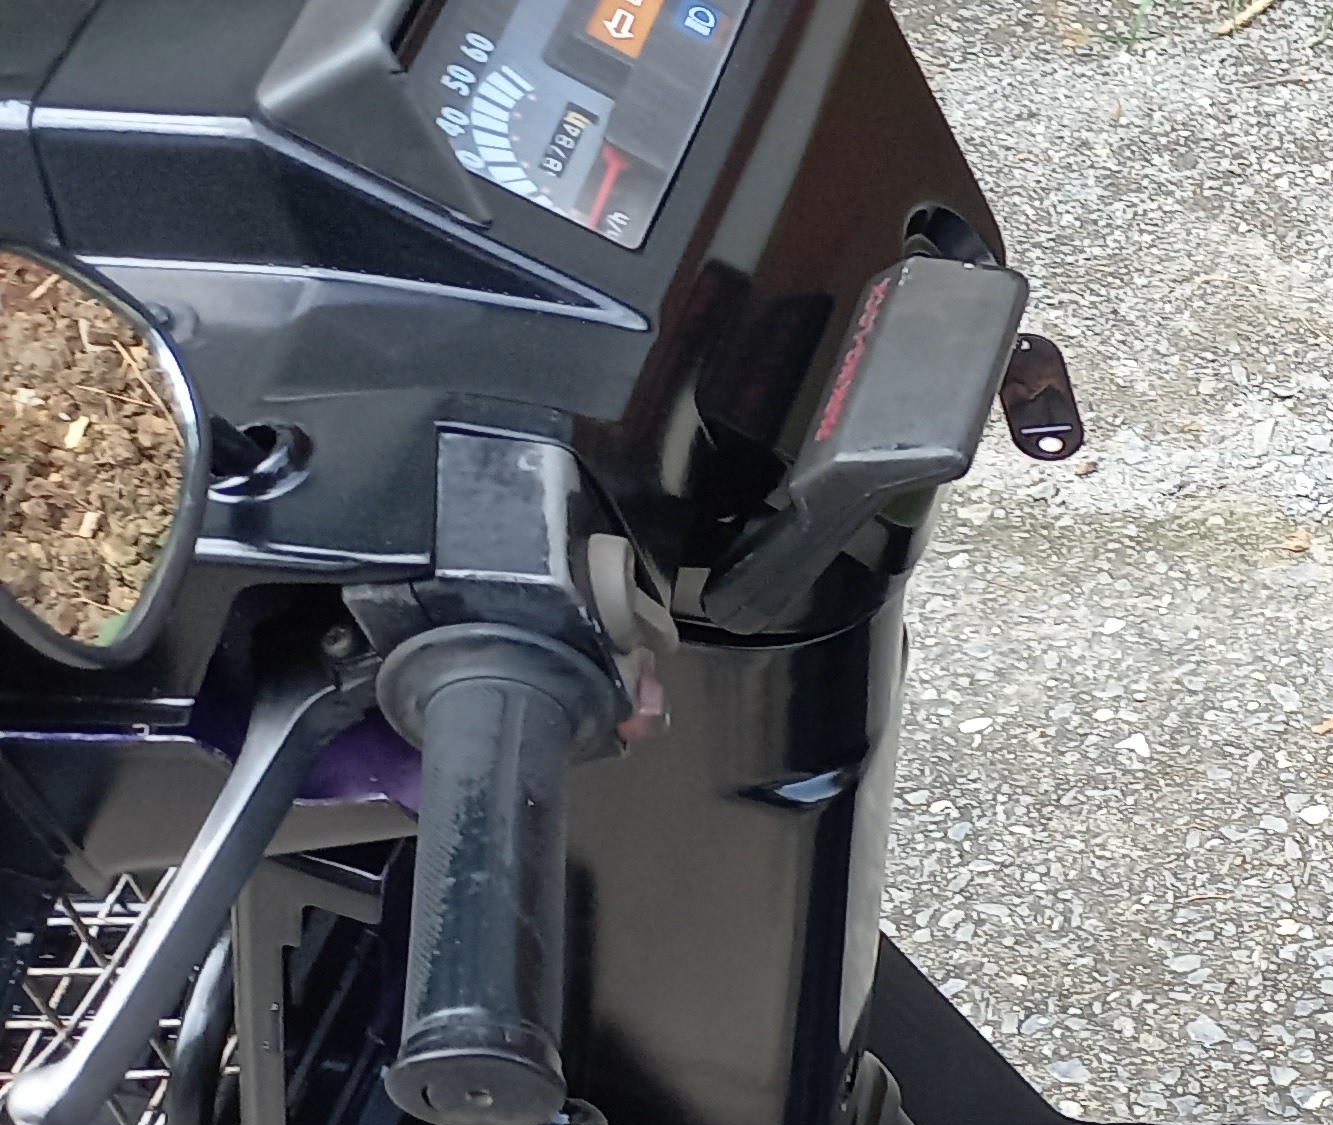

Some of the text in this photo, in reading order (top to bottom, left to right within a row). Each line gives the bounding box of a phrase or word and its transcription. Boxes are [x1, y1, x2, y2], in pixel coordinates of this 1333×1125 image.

[460, 31, 495, 64] 60
[440, 64, 476, 96] 50
[435, 106, 470, 137] 40
[455, 149, 485, 172] 0
